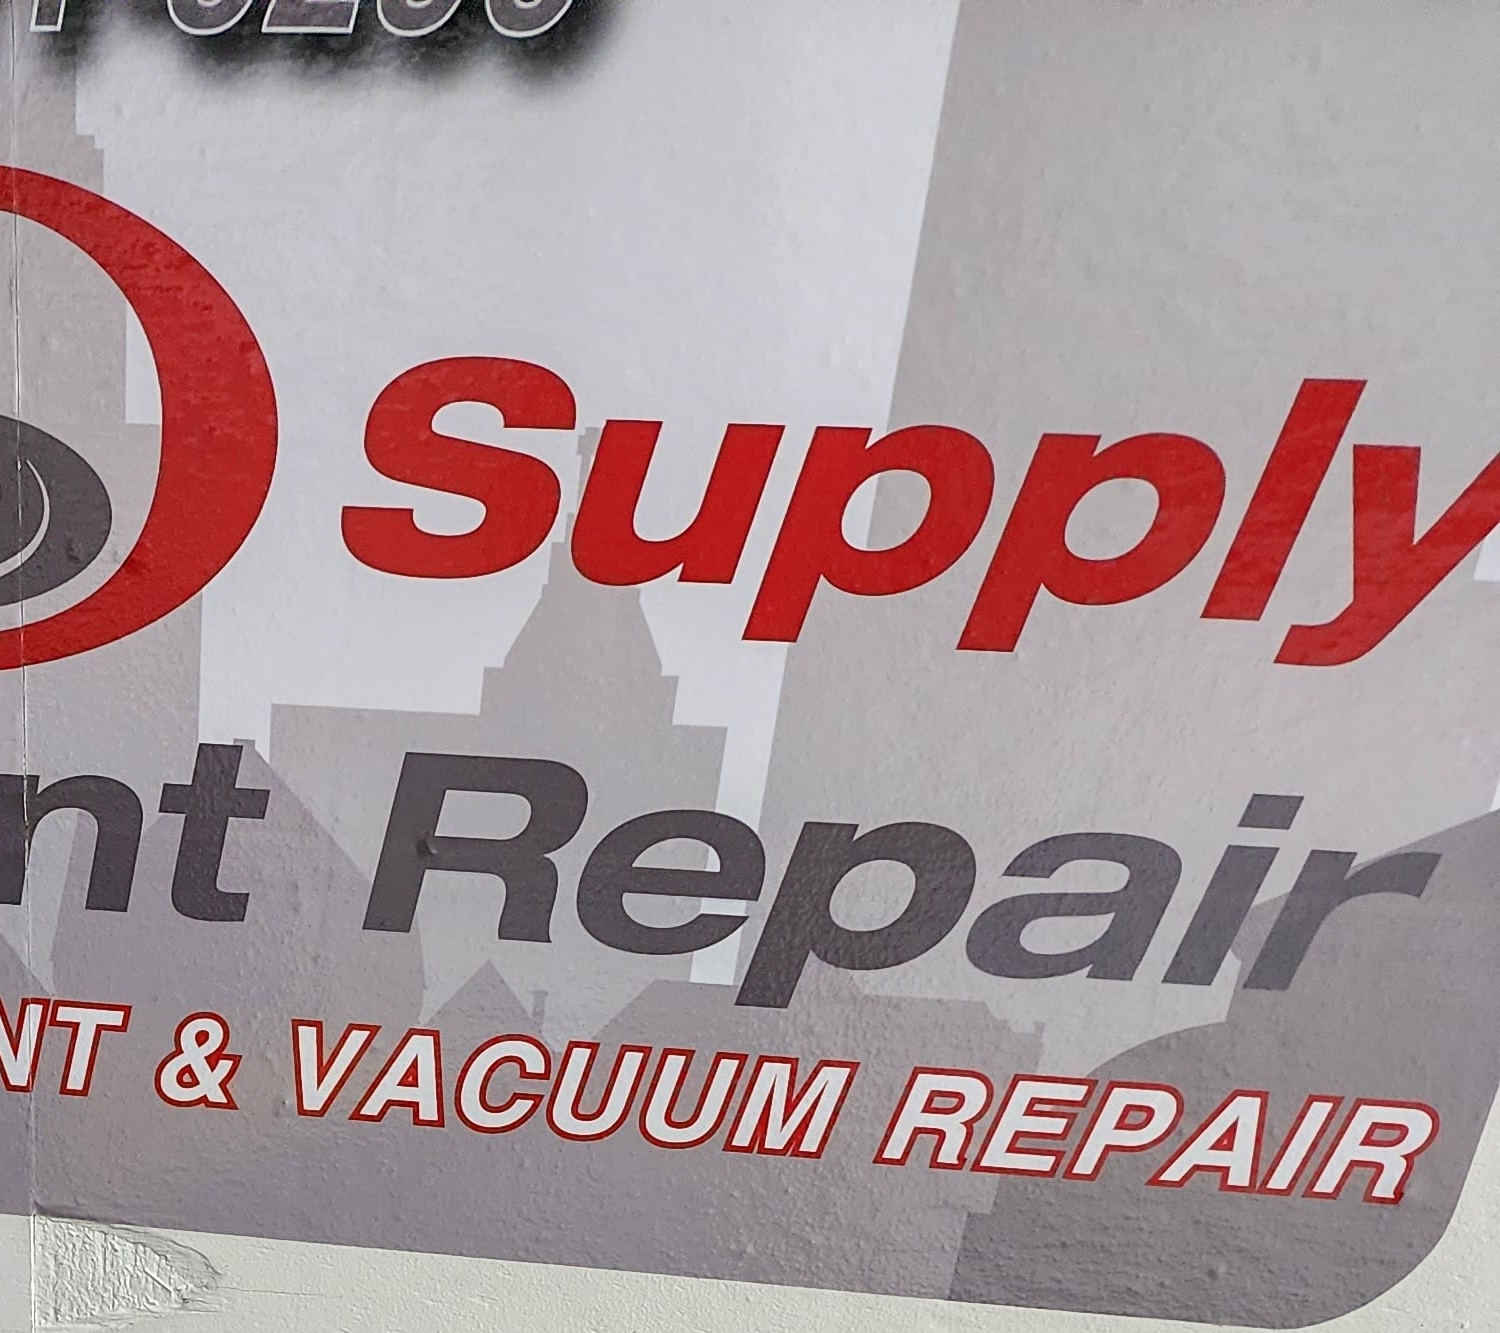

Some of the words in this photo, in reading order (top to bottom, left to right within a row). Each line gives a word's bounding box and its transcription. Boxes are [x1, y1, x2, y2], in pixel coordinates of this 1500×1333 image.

[341, 356, 1500, 667] Supply
[362, 749, 1442, 1008] Repair
[155, 1011, 243, 1111] &
[290, 1018, 860, 1158] VACUUM
[874, 1067, 1441, 1204] REPAIR
